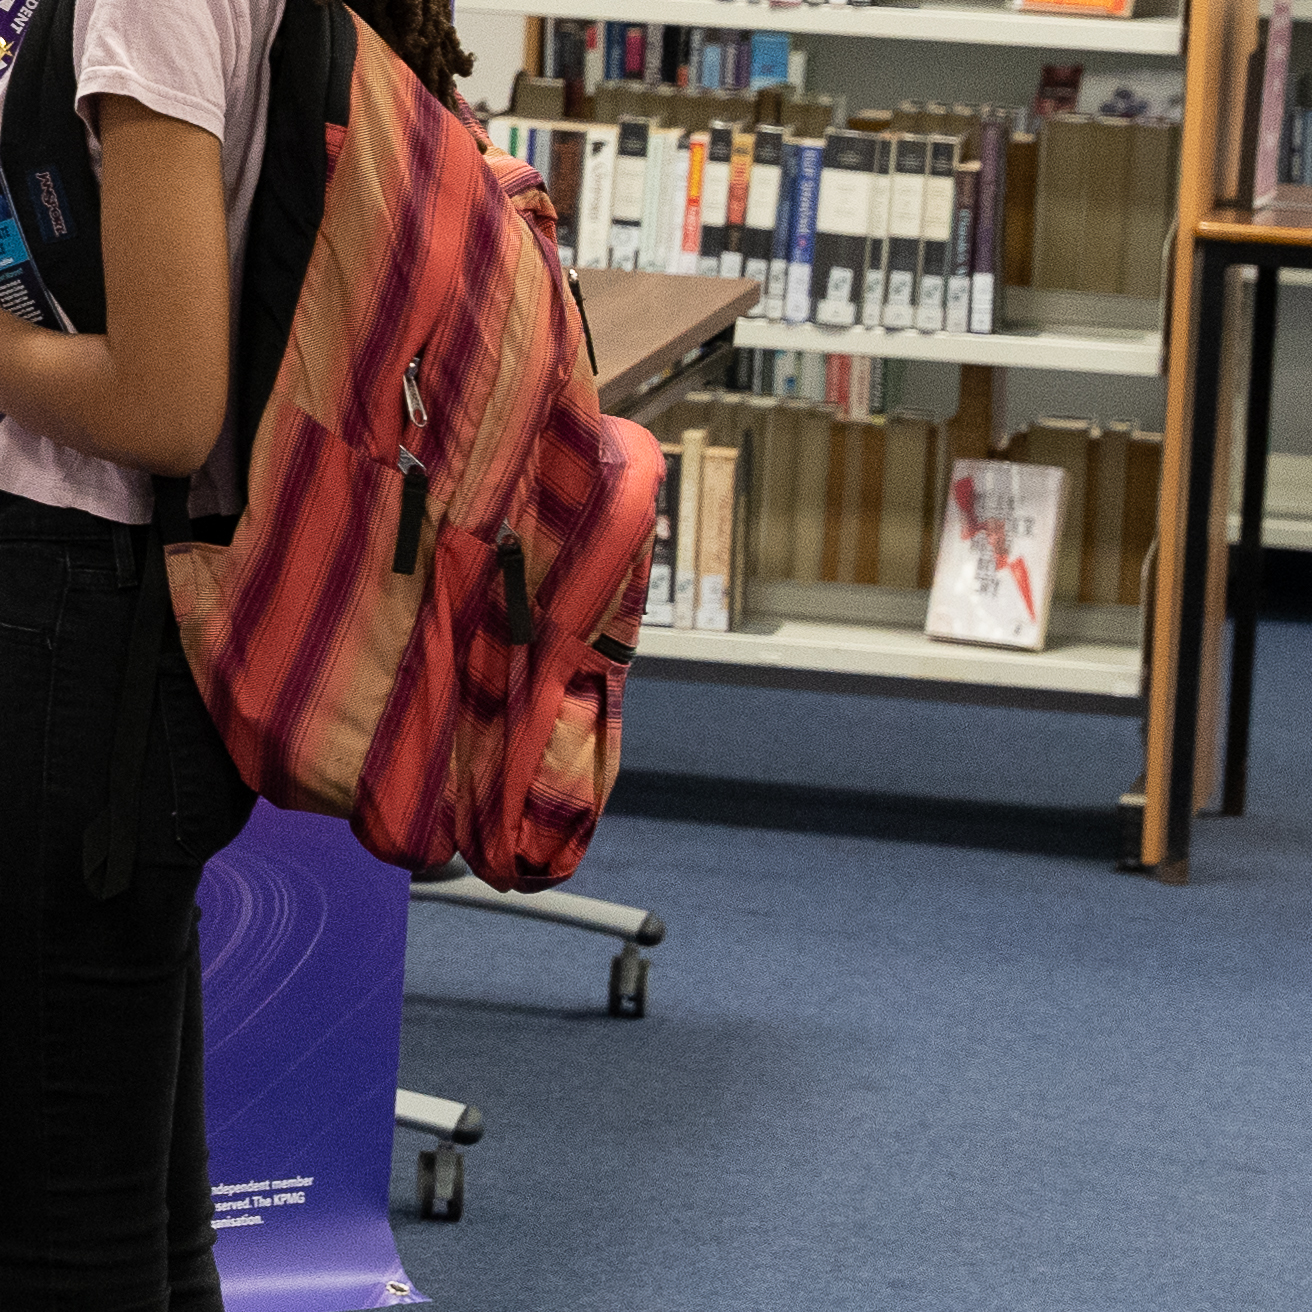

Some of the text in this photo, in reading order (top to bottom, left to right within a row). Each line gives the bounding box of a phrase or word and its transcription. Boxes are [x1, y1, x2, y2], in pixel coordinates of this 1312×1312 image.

[272, 1175, 314, 1190] member
[252, 1195, 272, 1208] The
[273, 1191, 305, 1206] KPMG
